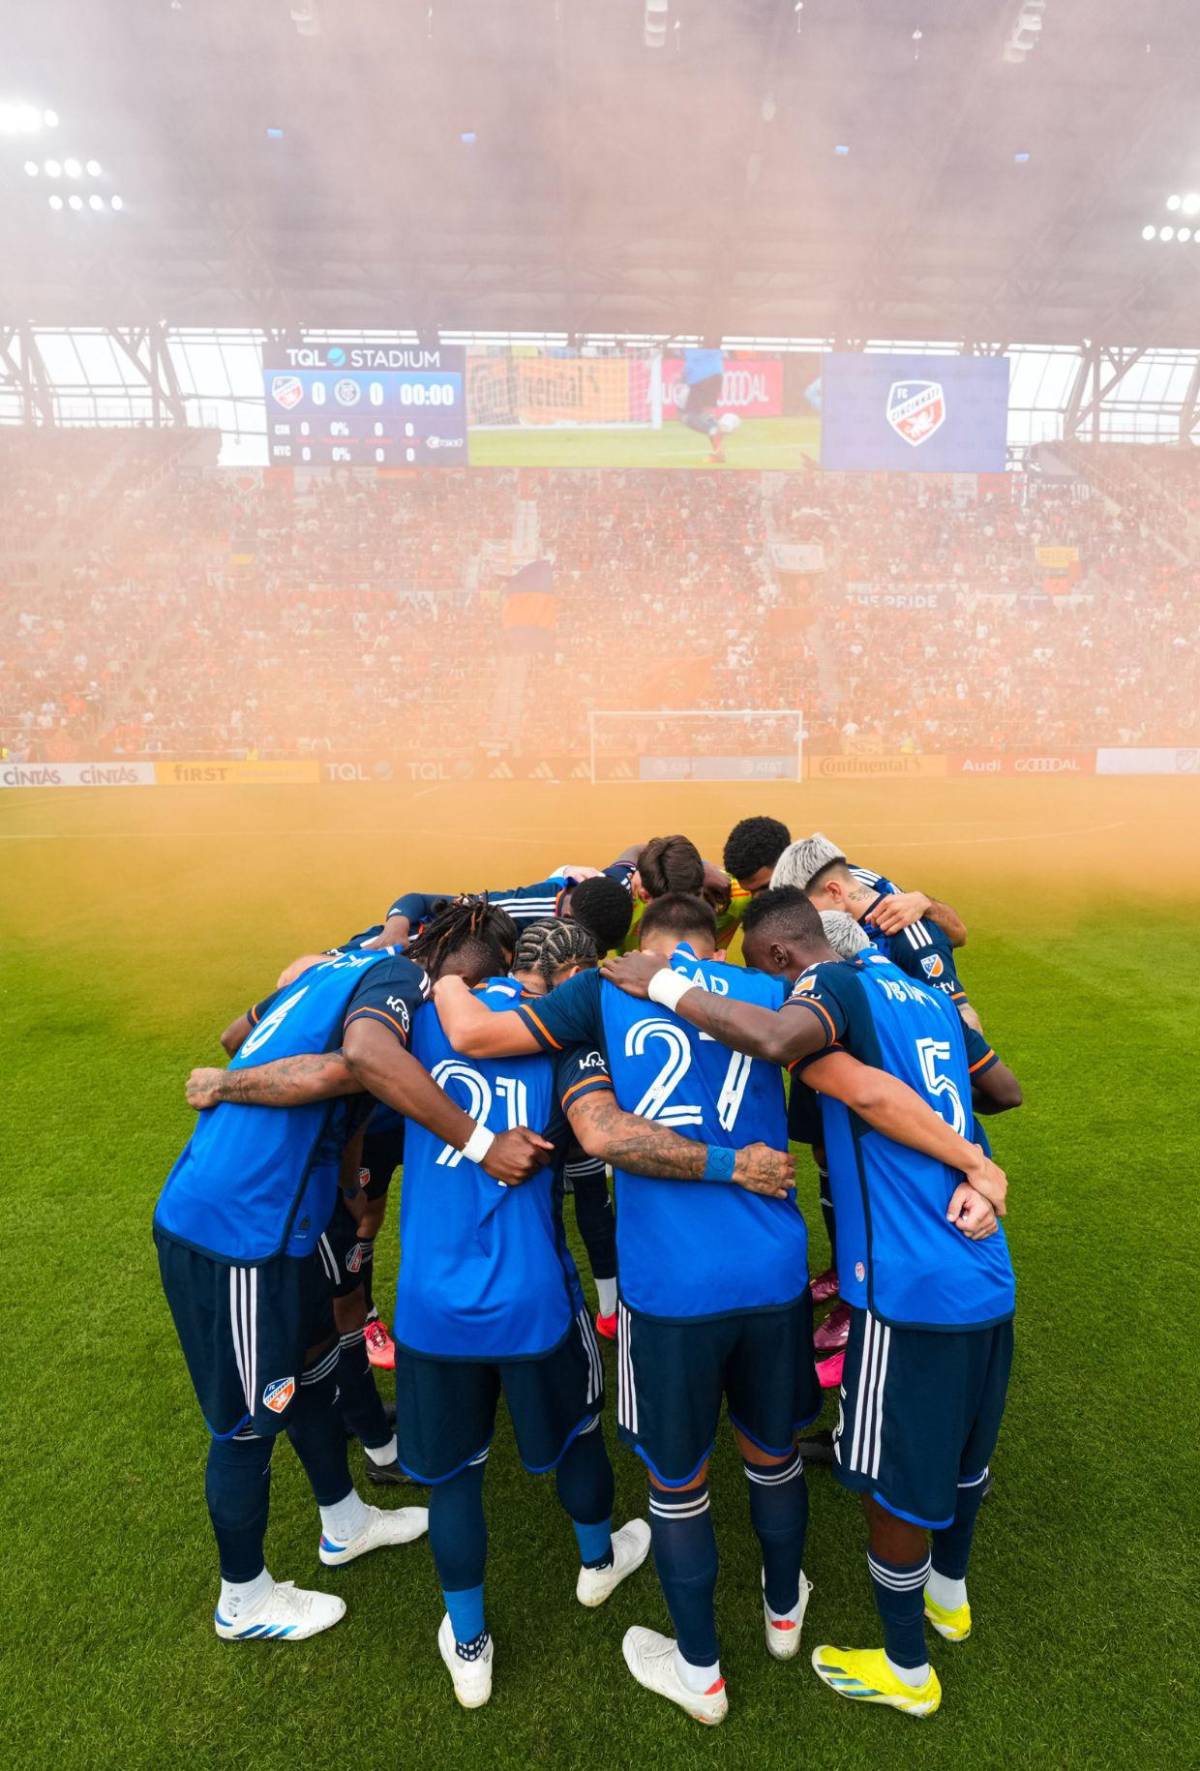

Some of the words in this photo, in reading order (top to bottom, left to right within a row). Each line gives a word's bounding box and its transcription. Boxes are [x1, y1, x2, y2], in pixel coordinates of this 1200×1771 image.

[286, 349, 327, 367] TQL
[350, 350, 441, 368] STADIUM
[312, 382, 326, 406] 0
[369, 382, 384, 406] 0
[400, 384, 454, 406] 00:00
[897, 388, 908, 399] FC
[330, 422, 350, 436] 0%
[332, 447, 351, 461] 0%
[883, 594, 938, 609] PRIDE
[325, 762, 371, 781] TQL
[408, 762, 450, 781] TQL
[819, 757, 909, 776] Continental
[961, 759, 1002, 772] Audi
[241, 985, 309, 1058] 6
[625, 1018, 752, 1132] 27
[915, 1037, 965, 1136] 5
[431, 1059, 527, 1170] 91
